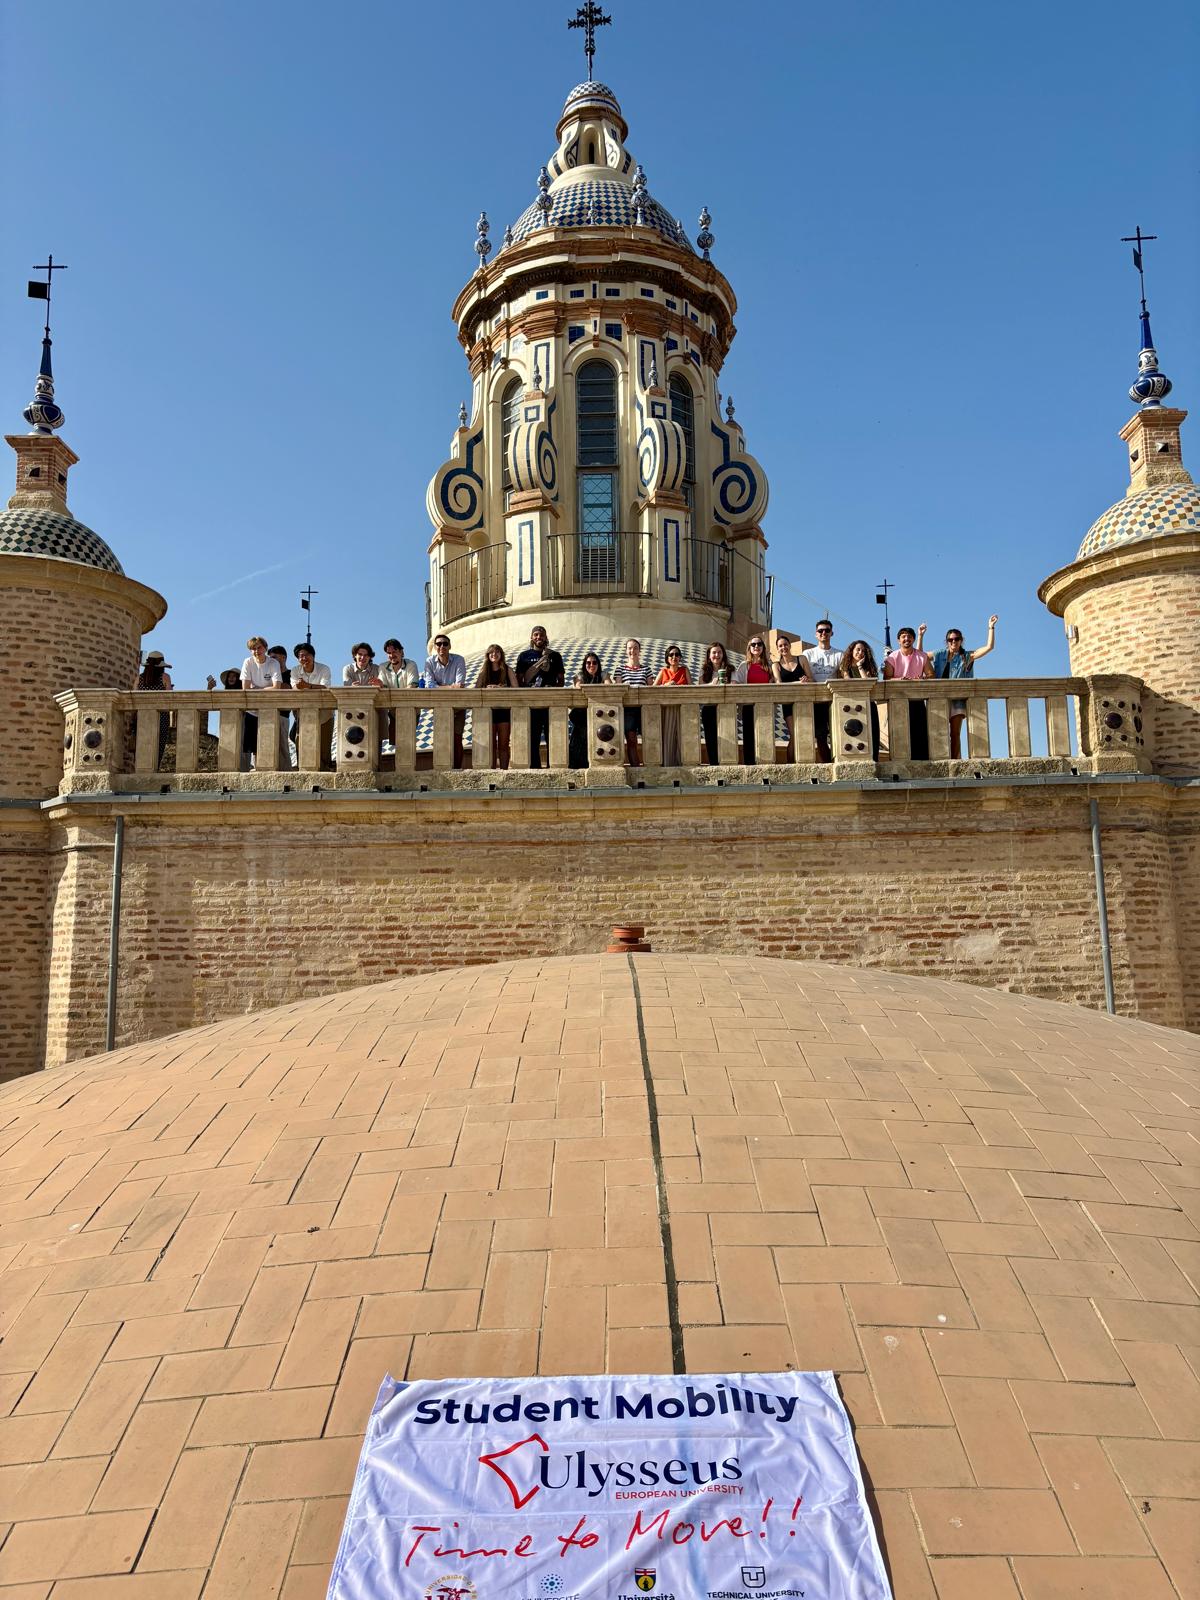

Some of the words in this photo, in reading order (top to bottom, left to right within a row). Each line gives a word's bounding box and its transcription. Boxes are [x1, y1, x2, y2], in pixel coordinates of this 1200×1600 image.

[413, 1394, 600, 1425] Student
[539, 1450, 743, 1498] Ulysseus
[615, 1490, 677, 1500] EUROPEAN
[680, 1484, 744, 1498] UNIVERSITY
[405, 1522, 538, 1567] Time
[557, 1514, 600, 1558] to
[706, 1591, 752, 1600] TECHNICAL
[755, 1589, 805, 1600] UNIVERSITY
